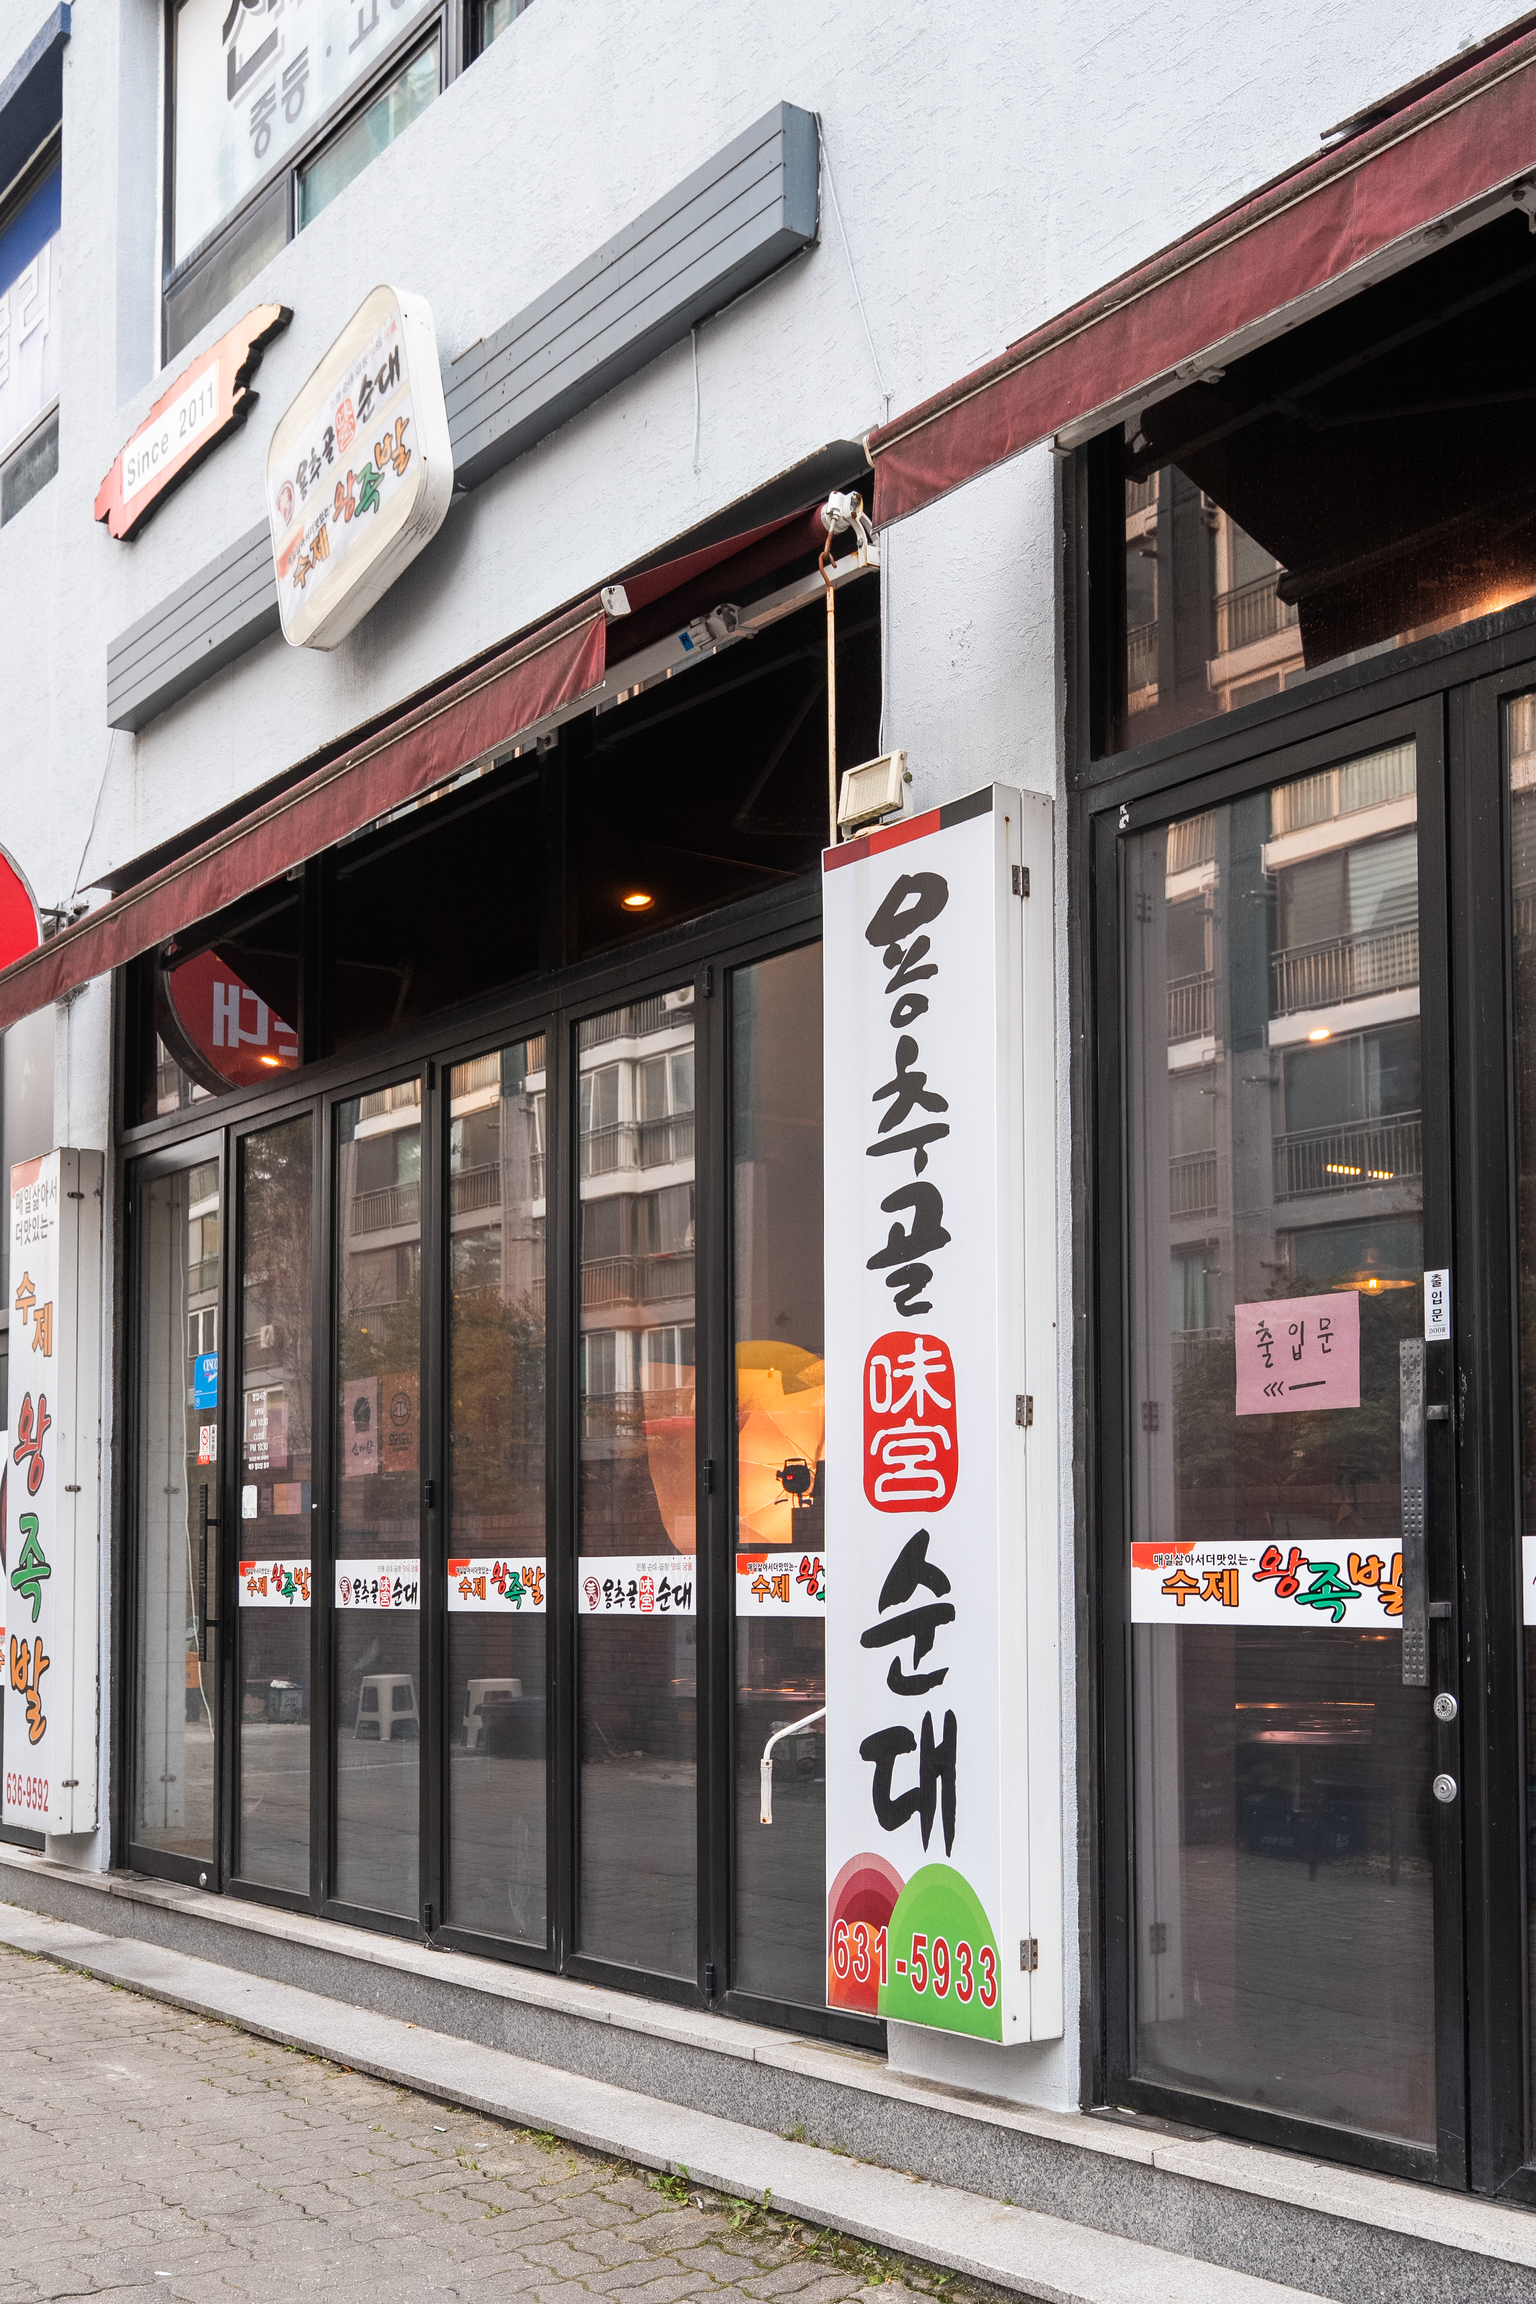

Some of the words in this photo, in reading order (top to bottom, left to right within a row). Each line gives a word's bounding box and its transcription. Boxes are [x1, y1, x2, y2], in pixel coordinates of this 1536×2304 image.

[126, 431, 170, 487] Since
[178, 381, 214, 438] 2011
[295, 425, 336, 501] 용추골
[356, 344, 401, 424] 순대
[293, 522, 331, 589] 수제
[332, 416, 412, 524] 왕족발
[864, 871, 952, 1317] 용추골
[15, 1176, 58, 1216] 매일삶아서
[15, 1270, 54, 1358] 수제
[1430, 1273, 1443, 1323] 출입문
[1429, 1326, 1446, 1335] DOOR
[250, 1419, 257, 1428] AM
[253, 1431, 265, 1440] CLOSE
[254, 1407, 265, 1416] OPEN
[250, 1443, 257, 1452] PM
[10, 1390, 52, 1747] 왕족발
[247, 1575, 268, 1597] 수제
[271, 1563, 311, 1605] 왕족발
[352, 1578, 379, 1605] 용추골
[391, 1576, 418, 1607] 순대
[458, 1576, 487, 1601] 수제
[490, 1561, 546, 1610] 왕족발
[751, 1573, 791, 1603] 수제
[796, 1555, 826, 1602] 왕
[1161, 1568, 1239, 1608] 수제
[1252, 1544, 1403, 1624] 왕족발
[602, 1578, 638, 1609] 용추골
[655, 1576, 693, 1612] 순대
[858, 1527, 958, 1859] 순대
[6, 1772, 50, 1814] 636-9592
[831, 1917, 999, 2008] 631-5933
